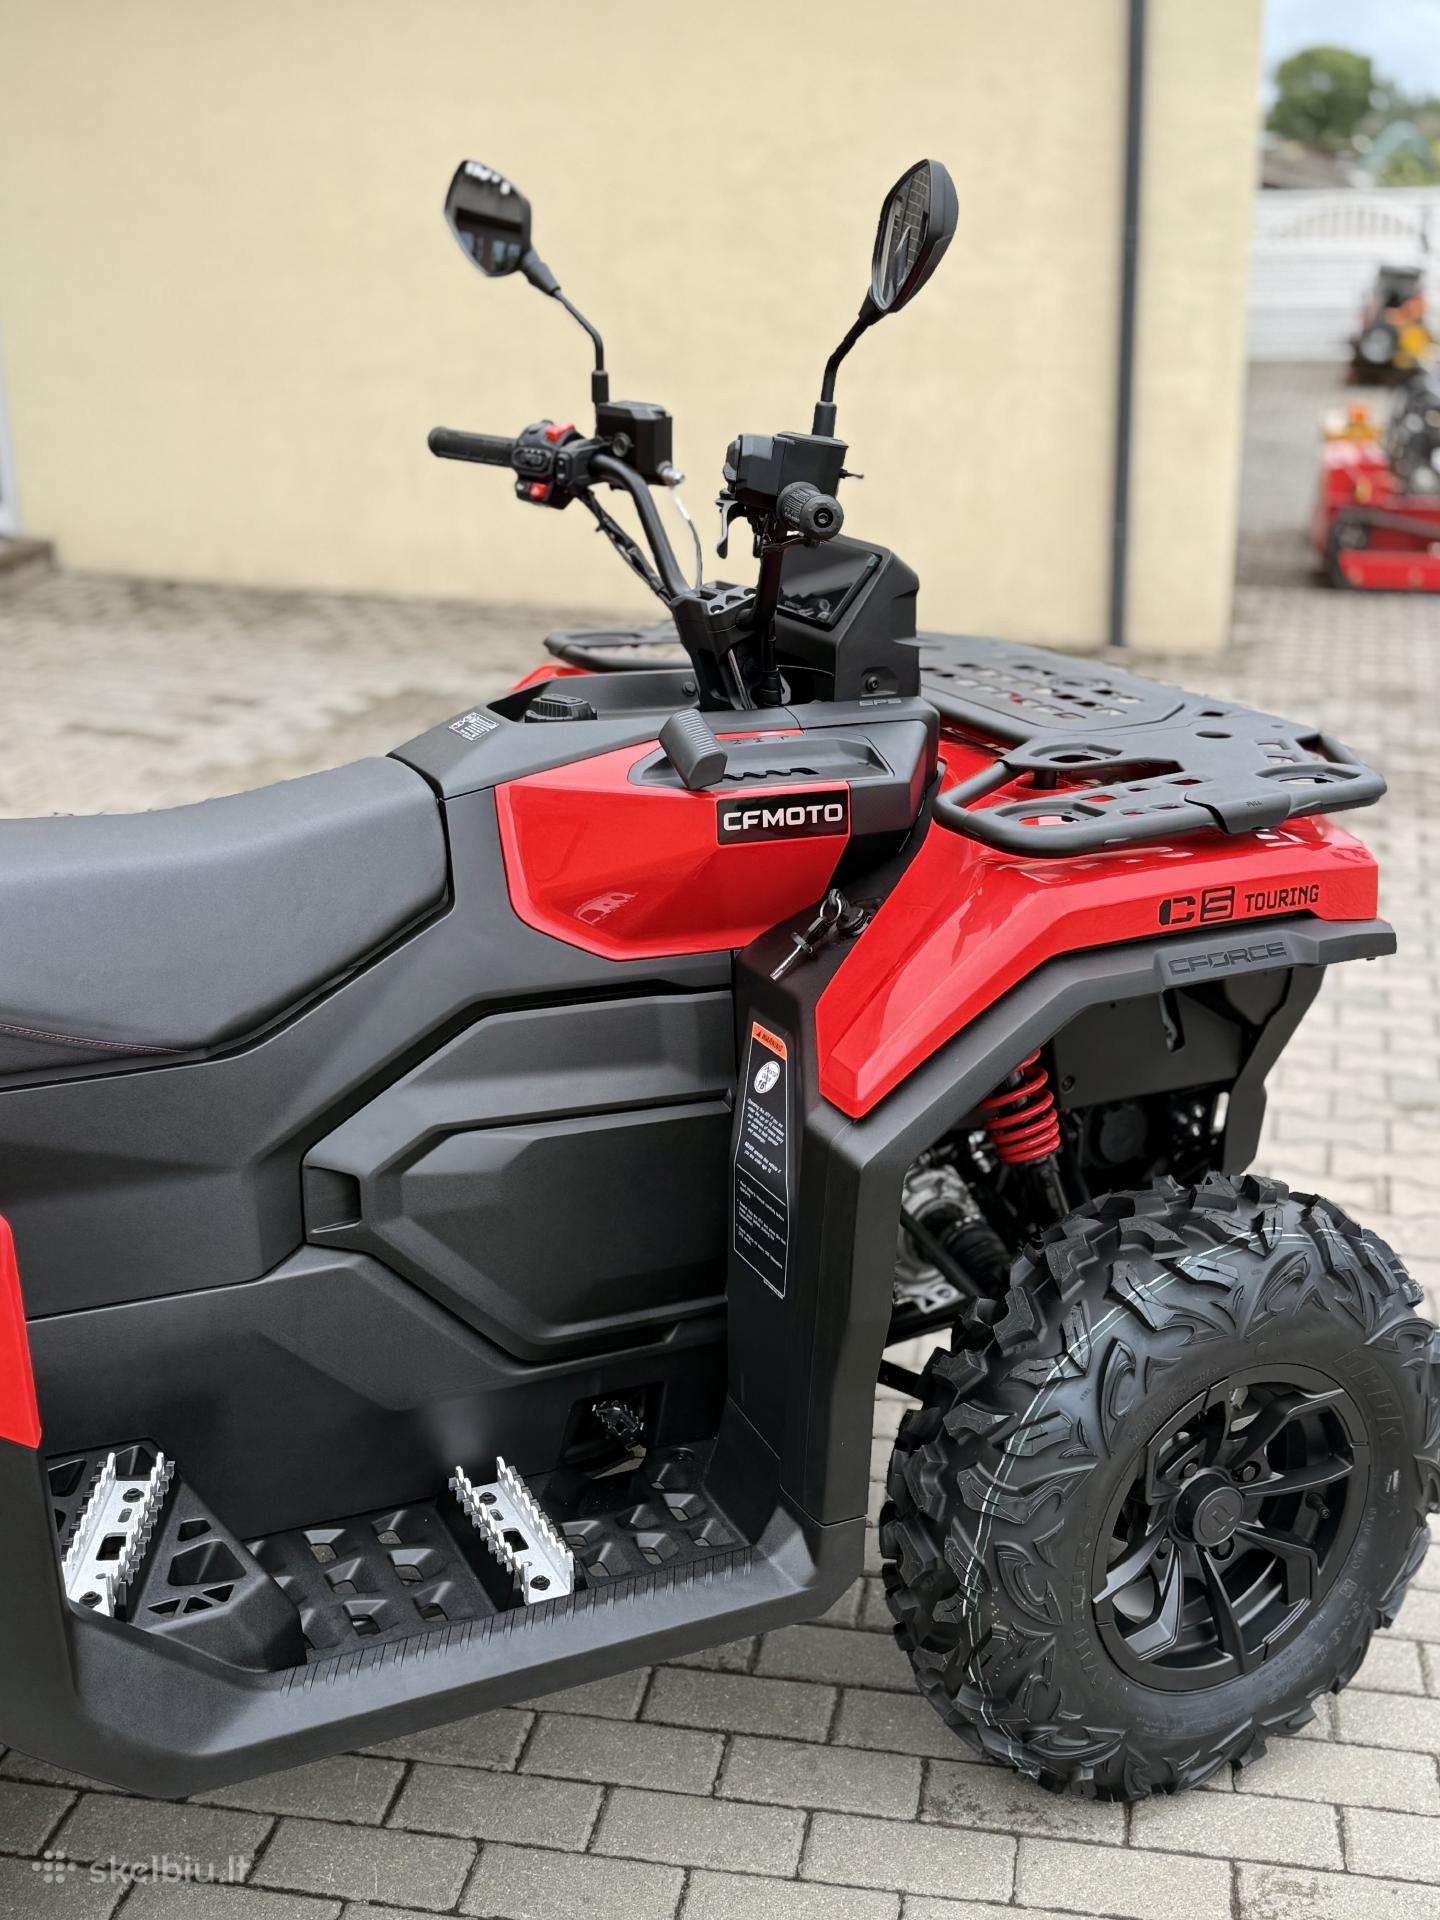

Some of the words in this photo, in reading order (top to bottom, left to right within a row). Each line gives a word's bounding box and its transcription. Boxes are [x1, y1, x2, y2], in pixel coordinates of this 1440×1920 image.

[723, 803, 843, 831] CFMOTO
[1245, 884, 1319, 912] TOURING
[1168, 941, 1287, 975] CFORCE
